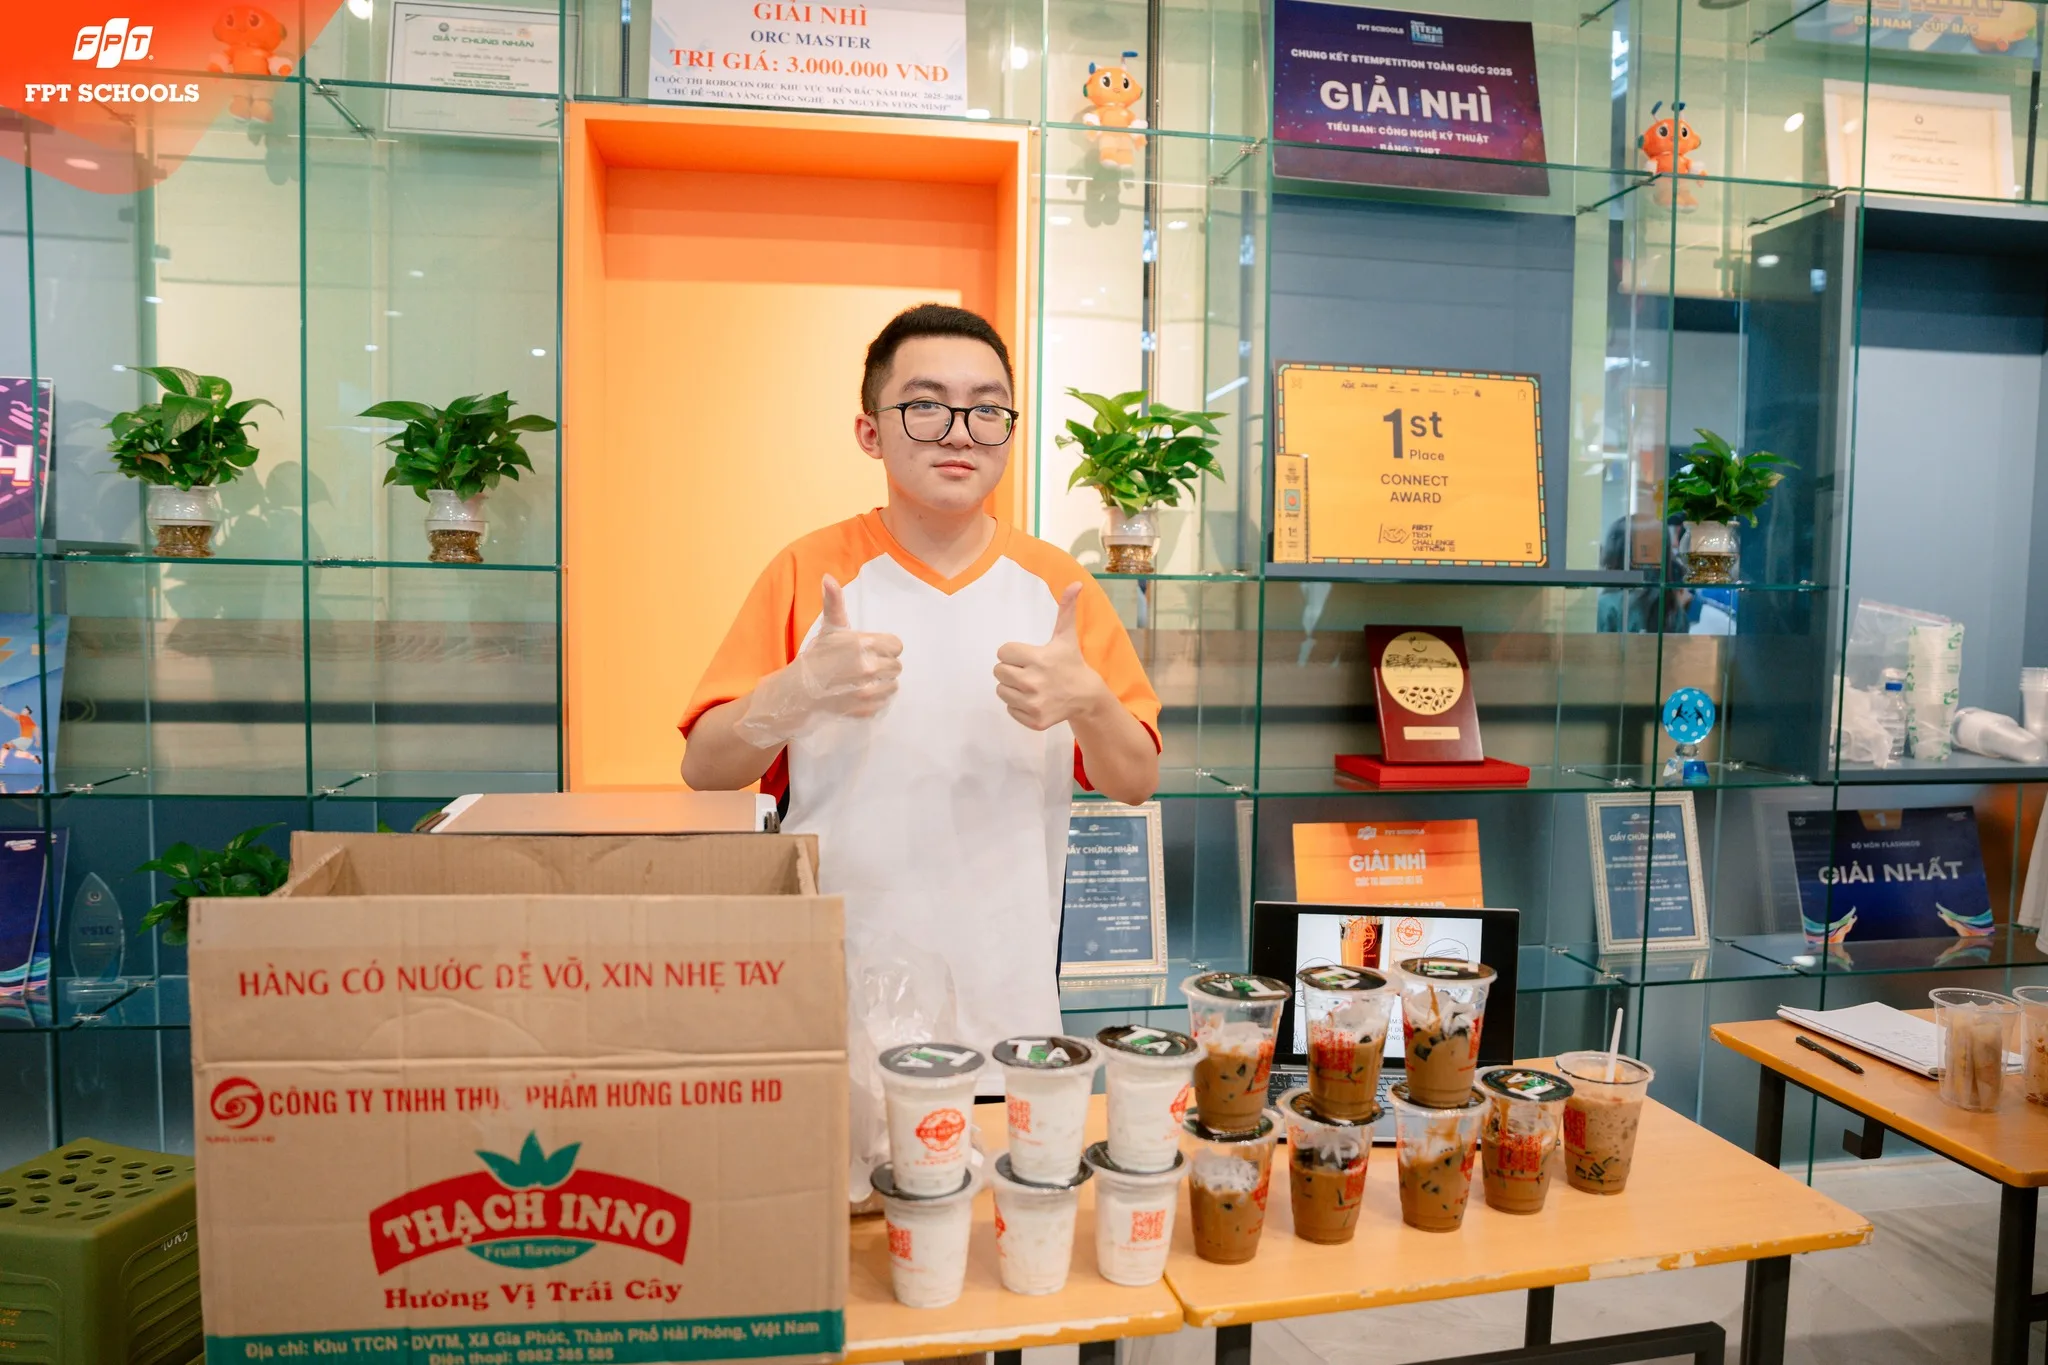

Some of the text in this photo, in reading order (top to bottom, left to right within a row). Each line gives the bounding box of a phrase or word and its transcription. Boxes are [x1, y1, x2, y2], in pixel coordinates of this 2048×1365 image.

[820, 4, 867, 26] NHÌ
[750, 29, 871, 49] ORC MASTER
[669, 48, 949, 82] TRỊ GIÁ: 3.000.000 VNĐ
[1290, 48, 1513, 77] CHUNG KẾT STEMPETITION TOÀN QUỐC 2025
[705, 79, 755, 89] ROBOCON
[1319, 75, 1493, 123] GIẢI NHÌ
[1352, 125, 1377, 134] BAN:
[1378, 125, 1409, 137] CÔNG
[1409, 128, 1438, 142] NGHỆ
[1455, 133, 1489, 145] THUẬT
[1383, 408, 1444, 460] 1st
[1409, 449, 1445, 462] Place
[1380, 473, 1449, 487] CONNECT
[1390, 491, 1442, 504] AWARD
[1411, 538, 1455, 546] CHALLENGE
[1349, 848, 1427, 873] GIẢI NHÌ
[1818, 856, 1963, 885] GIẢI NHẤT
[238, 961, 329, 997] HÀNG
[341, 958, 385, 995] CÓ
[397, 956, 483, 992] NƯỚC
[602, 961, 653, 989] XIN
[664, 961, 726, 994] NHẸ
[734, 959, 786, 987] TAY
[268, 1085, 338, 1117] CÔNG
[346, 1088, 374, 1114] TY
[383, 1087, 446, 1113] TNHH
[526, 1072, 598, 1109] PHẨM
[607, 1081, 672, 1108] HƯNG
[680, 1079, 743, 1107] LONG
[751, 1078, 783, 1103] HD
[382, 1191, 677, 1255] THẠCH INNO
[483, 1243, 521, 1258] Fruit
[384, 1278, 683, 1311] Hương Vị Trái Cây
[244, 1341, 274, 1360] Địa
[313, 1338, 348, 1354] Khu
[352, 1336, 398, 1352] TTCN
[493, 1331, 521, 1346] Gia
[574, 1328, 623, 1343] Thành
[627, 1324, 659, 1342] Phố
[751, 1321, 781, 1338] Việt
[784, 1320, 820, 1335] Nam
